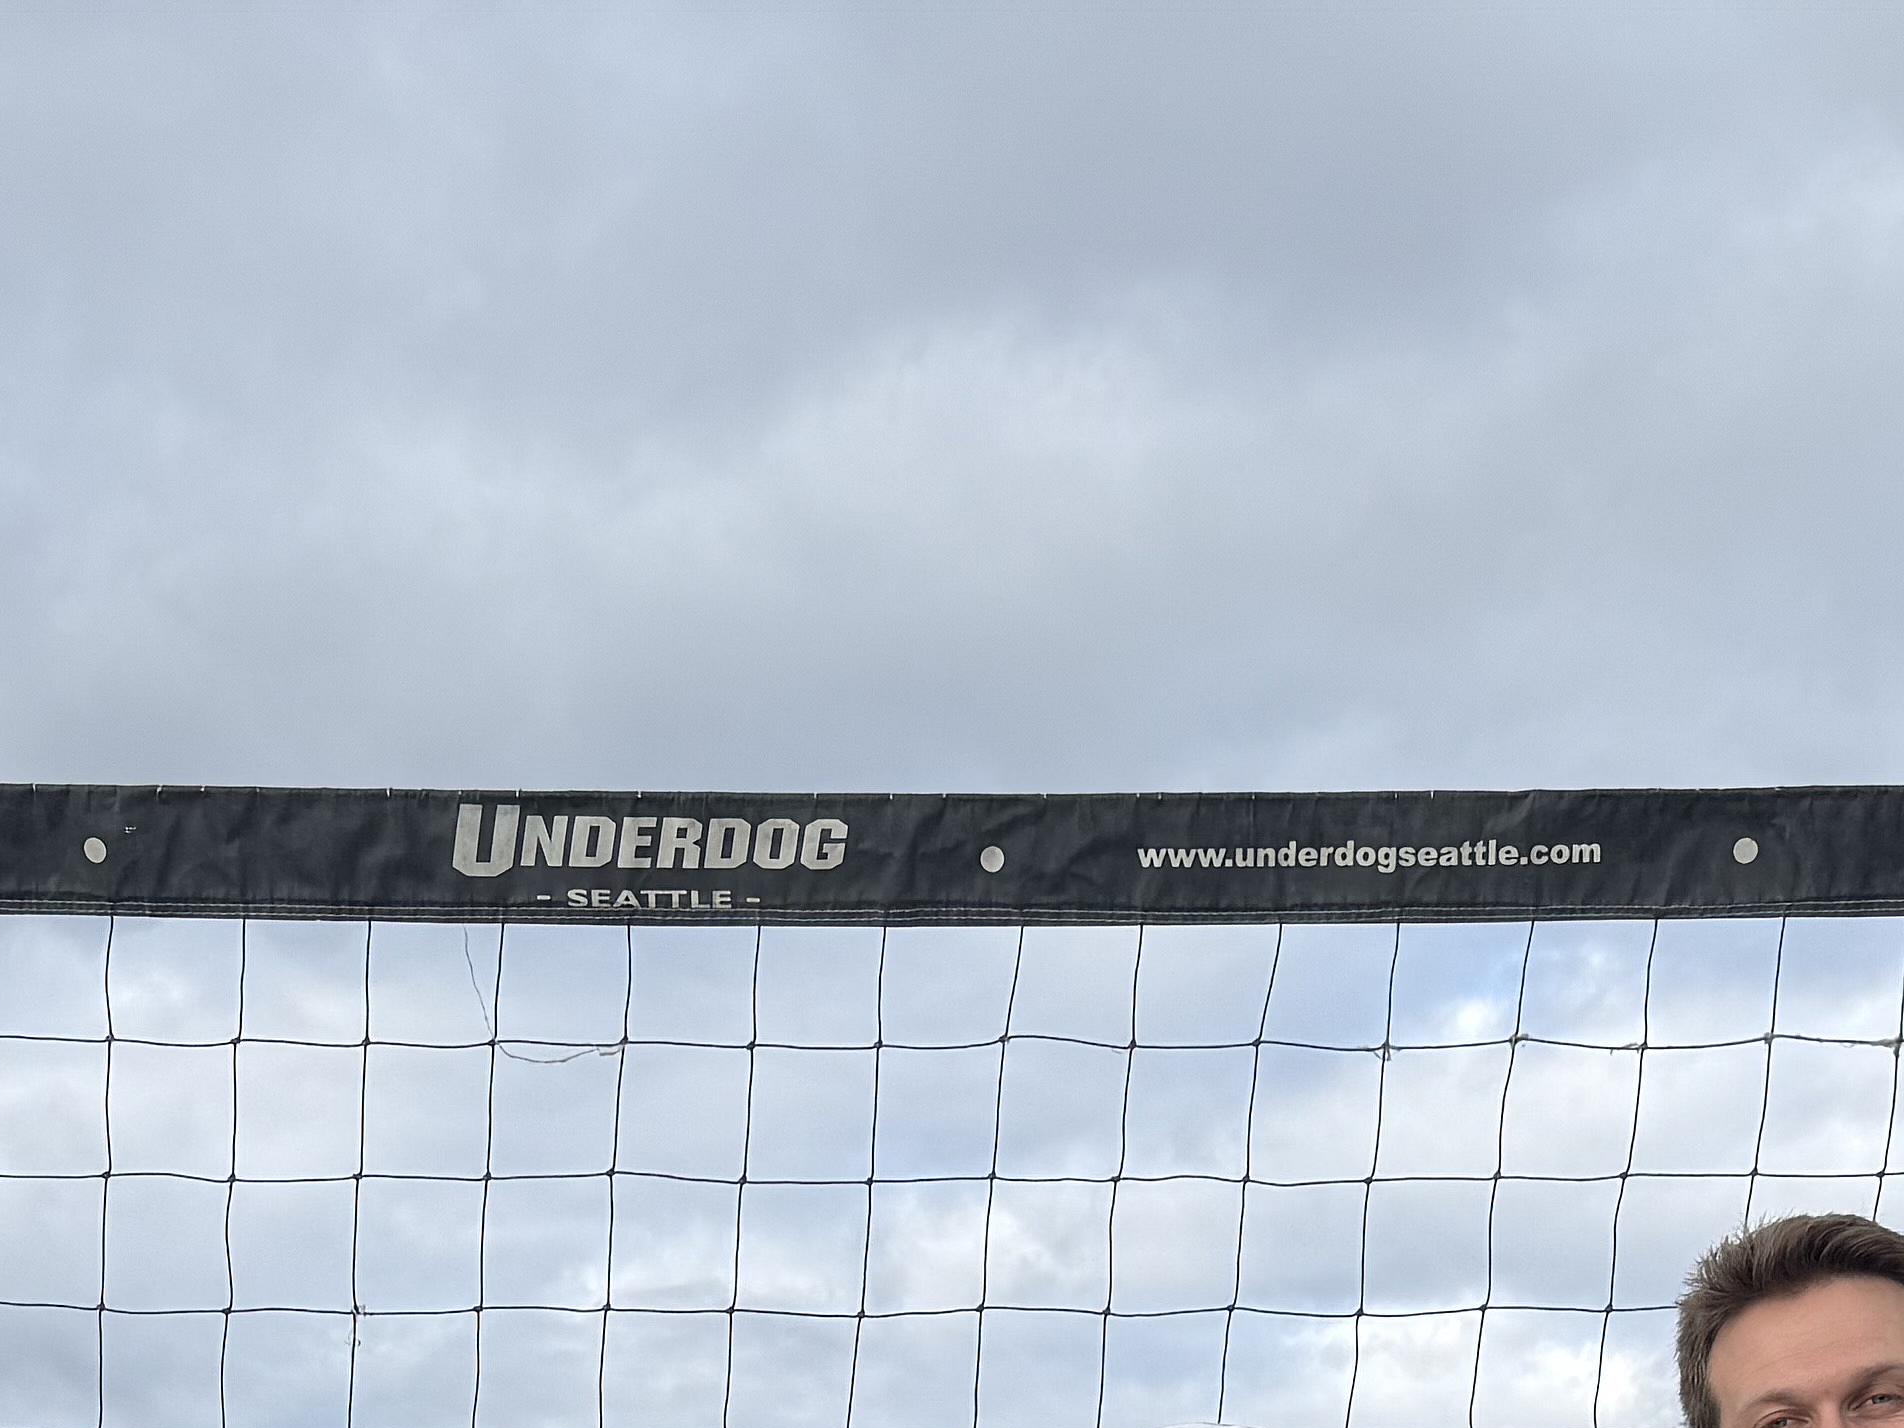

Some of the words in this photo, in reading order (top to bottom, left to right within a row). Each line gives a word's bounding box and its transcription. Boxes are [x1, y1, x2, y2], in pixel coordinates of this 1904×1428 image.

[452, 803, 849, 877] UNDERDOG
[1137, 839, 1601, 874] www.underdogseattle.com
[567, 888, 732, 909] SEATTLE
